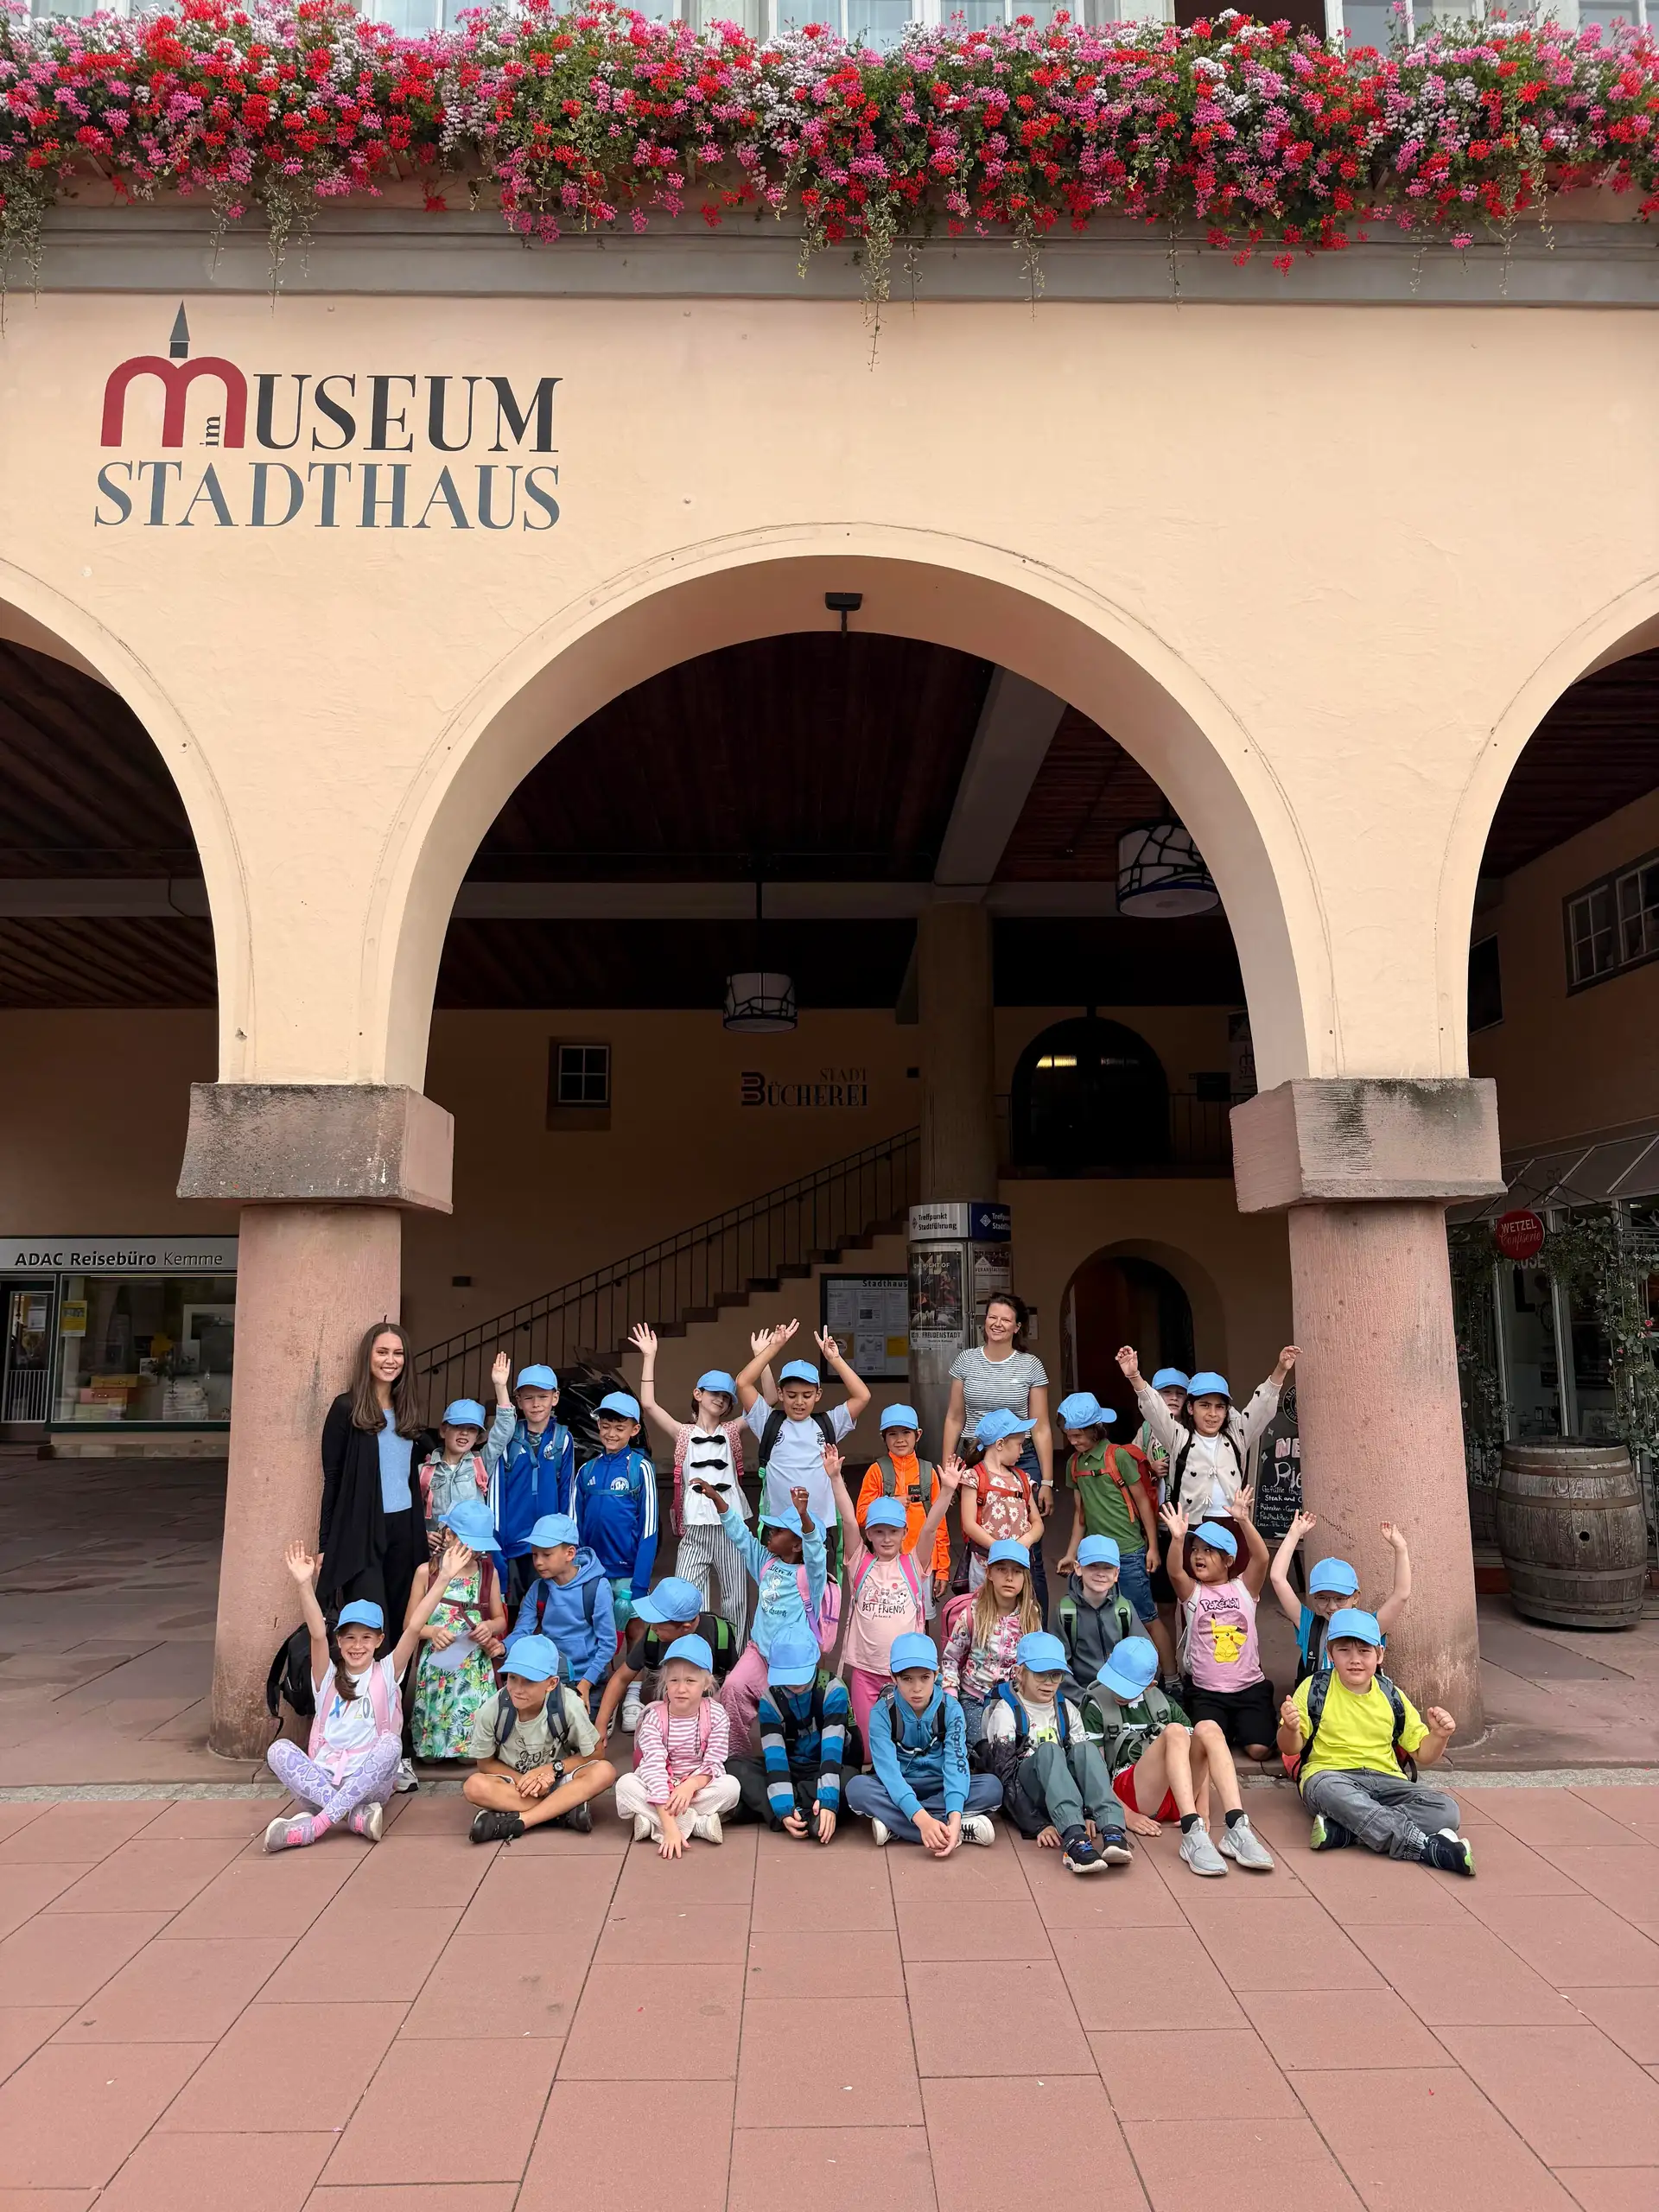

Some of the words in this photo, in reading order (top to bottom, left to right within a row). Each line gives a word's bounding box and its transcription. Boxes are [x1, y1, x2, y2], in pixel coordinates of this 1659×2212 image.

[200, 415, 221, 448] im
[94, 460, 561, 531] STADTHAUS
[820, 1067, 868, 1082] STADT
[741, 1071, 868, 1107] BÜCHEREI
[918, 1212, 948, 1221] Treffpunkt
[918, 1220, 957, 1230] Stadtführung
[1501, 1218, 1537, 1233] WETZEL
[1498, 1230, 1541, 1251] Confiserie
[16, 1253, 63, 1266] ADAC
[70, 1251, 156, 1266] Reisebüro
[163, 1252, 223, 1266] Kemme
[1274, 1438, 1300, 1459] NE
[862, 1602, 876, 1612] BEST
[878, 1603, 906, 1615] FRIENDS
